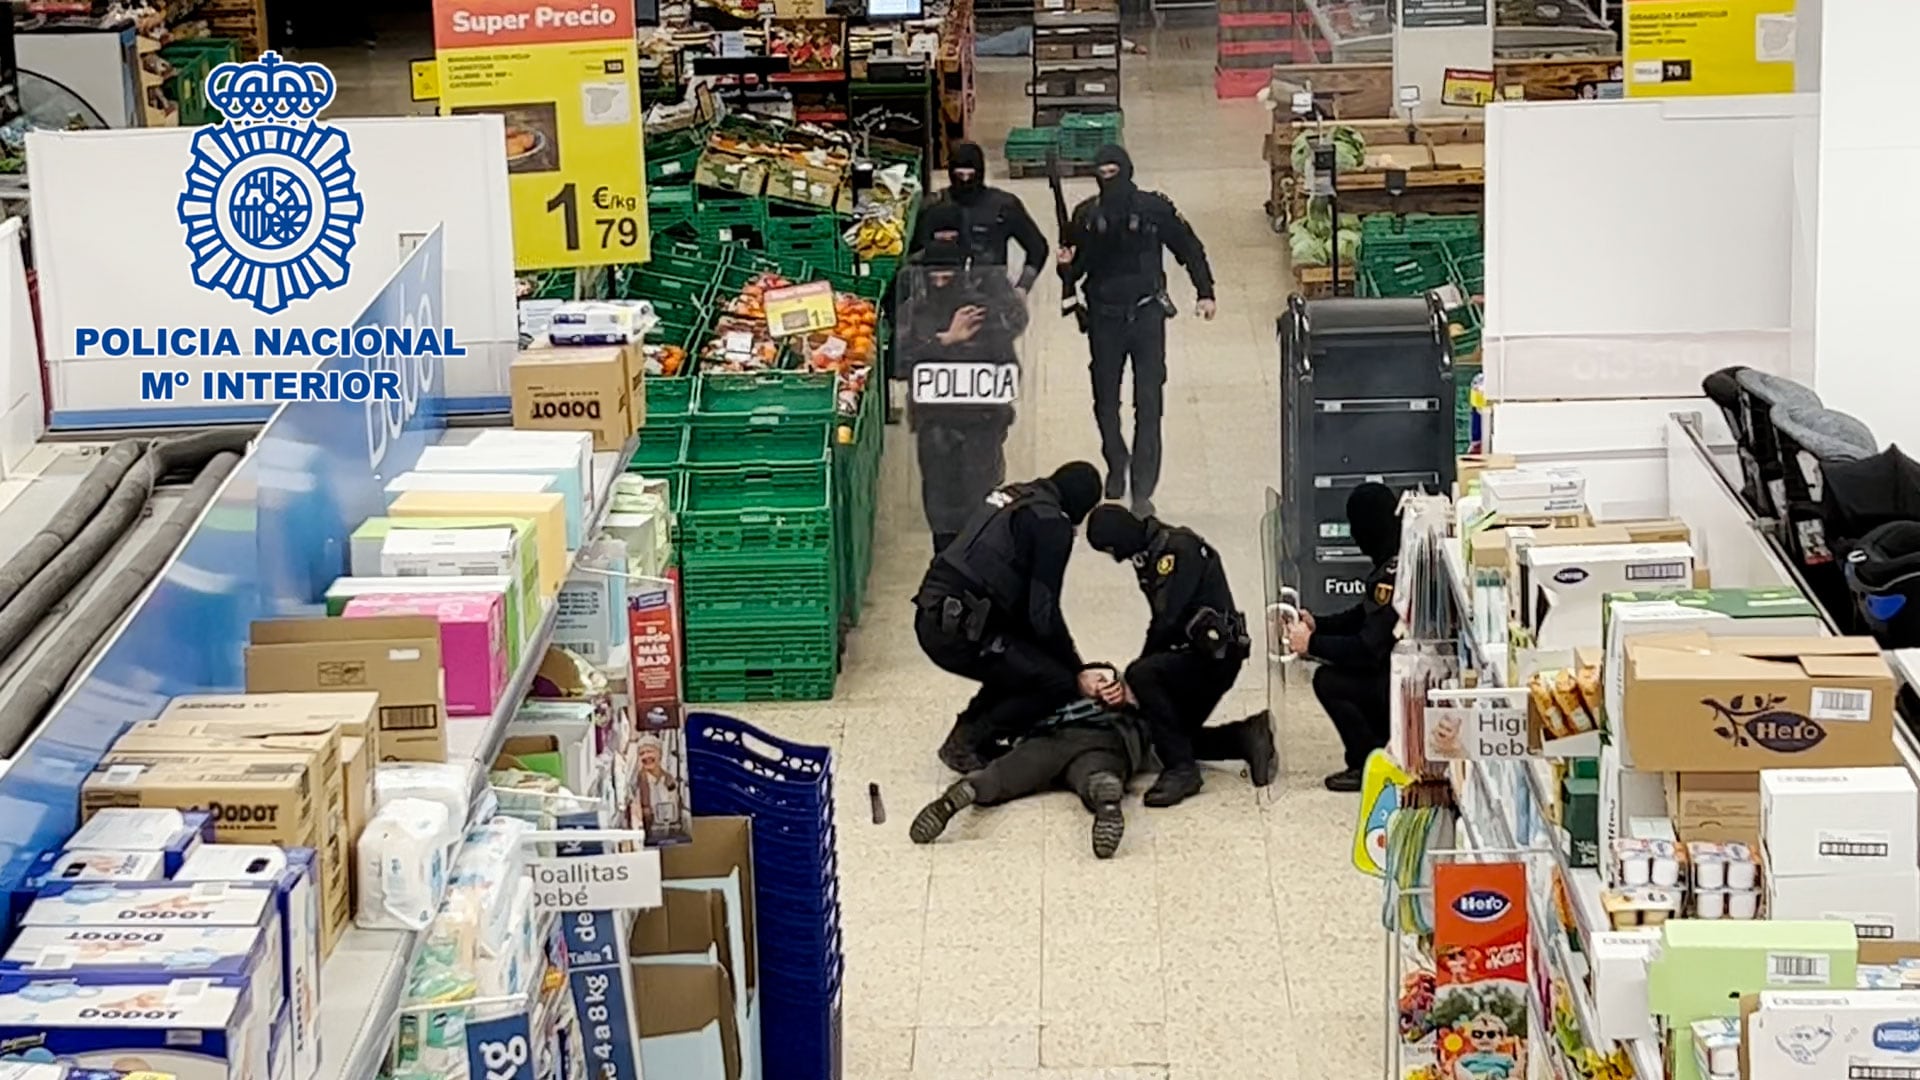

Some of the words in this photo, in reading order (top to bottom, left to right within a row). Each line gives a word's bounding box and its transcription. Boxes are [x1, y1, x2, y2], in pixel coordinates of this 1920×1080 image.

[453, 11, 530, 35] Super
[535, 4, 616, 28] Precio
[593, 187, 636, 212] €/kg
[547, 183, 580, 251] 1
[596, 218, 638, 248] 79
[530, 400, 601, 419] DODOT
[1756, 721, 1819, 740] Hero
[208, 802, 278, 822] DODOT
[526, 862, 629, 886] Toallitas
[1460, 895, 1504, 911] Hero
[117, 909, 215, 920] DODOT
[65, 930, 165, 942] DODOT
[585, 974, 609, 1002] kg
[78, 1007, 183, 1020] DODOT
[588, 1005, 609, 1021] 8
[593, 1042, 612, 1058] 4
